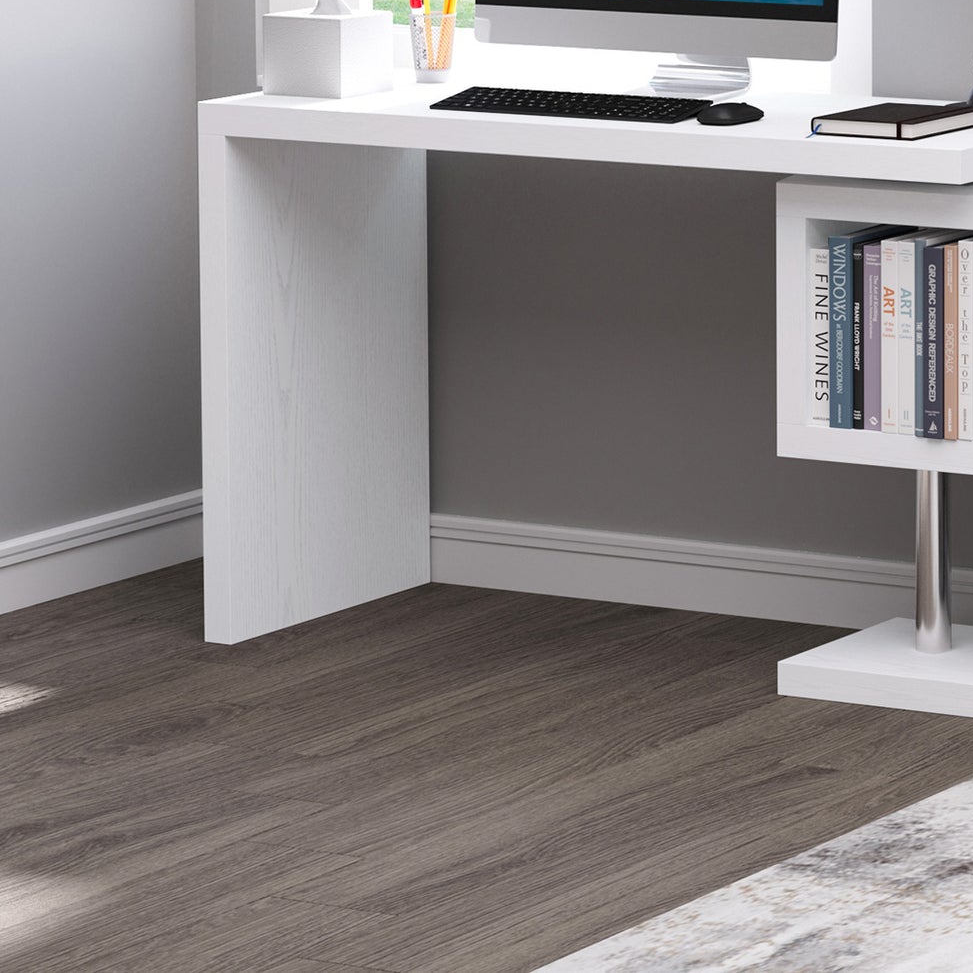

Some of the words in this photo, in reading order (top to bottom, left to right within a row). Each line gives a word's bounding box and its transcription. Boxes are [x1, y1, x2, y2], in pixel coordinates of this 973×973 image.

[815, 273, 829, 321] FINE
[833, 244, 846, 321] WINDOWS
[883, 286, 895, 317] ART
[900, 288, 912, 318] ART
[928, 264, 936, 305] GRAPHIC
[928, 307, 936, 341] DESIGN
[946, 323, 954, 373] BORDEAUX
[815, 331, 829, 401] WINES
[928, 342, 936, 402] REFERENCED
